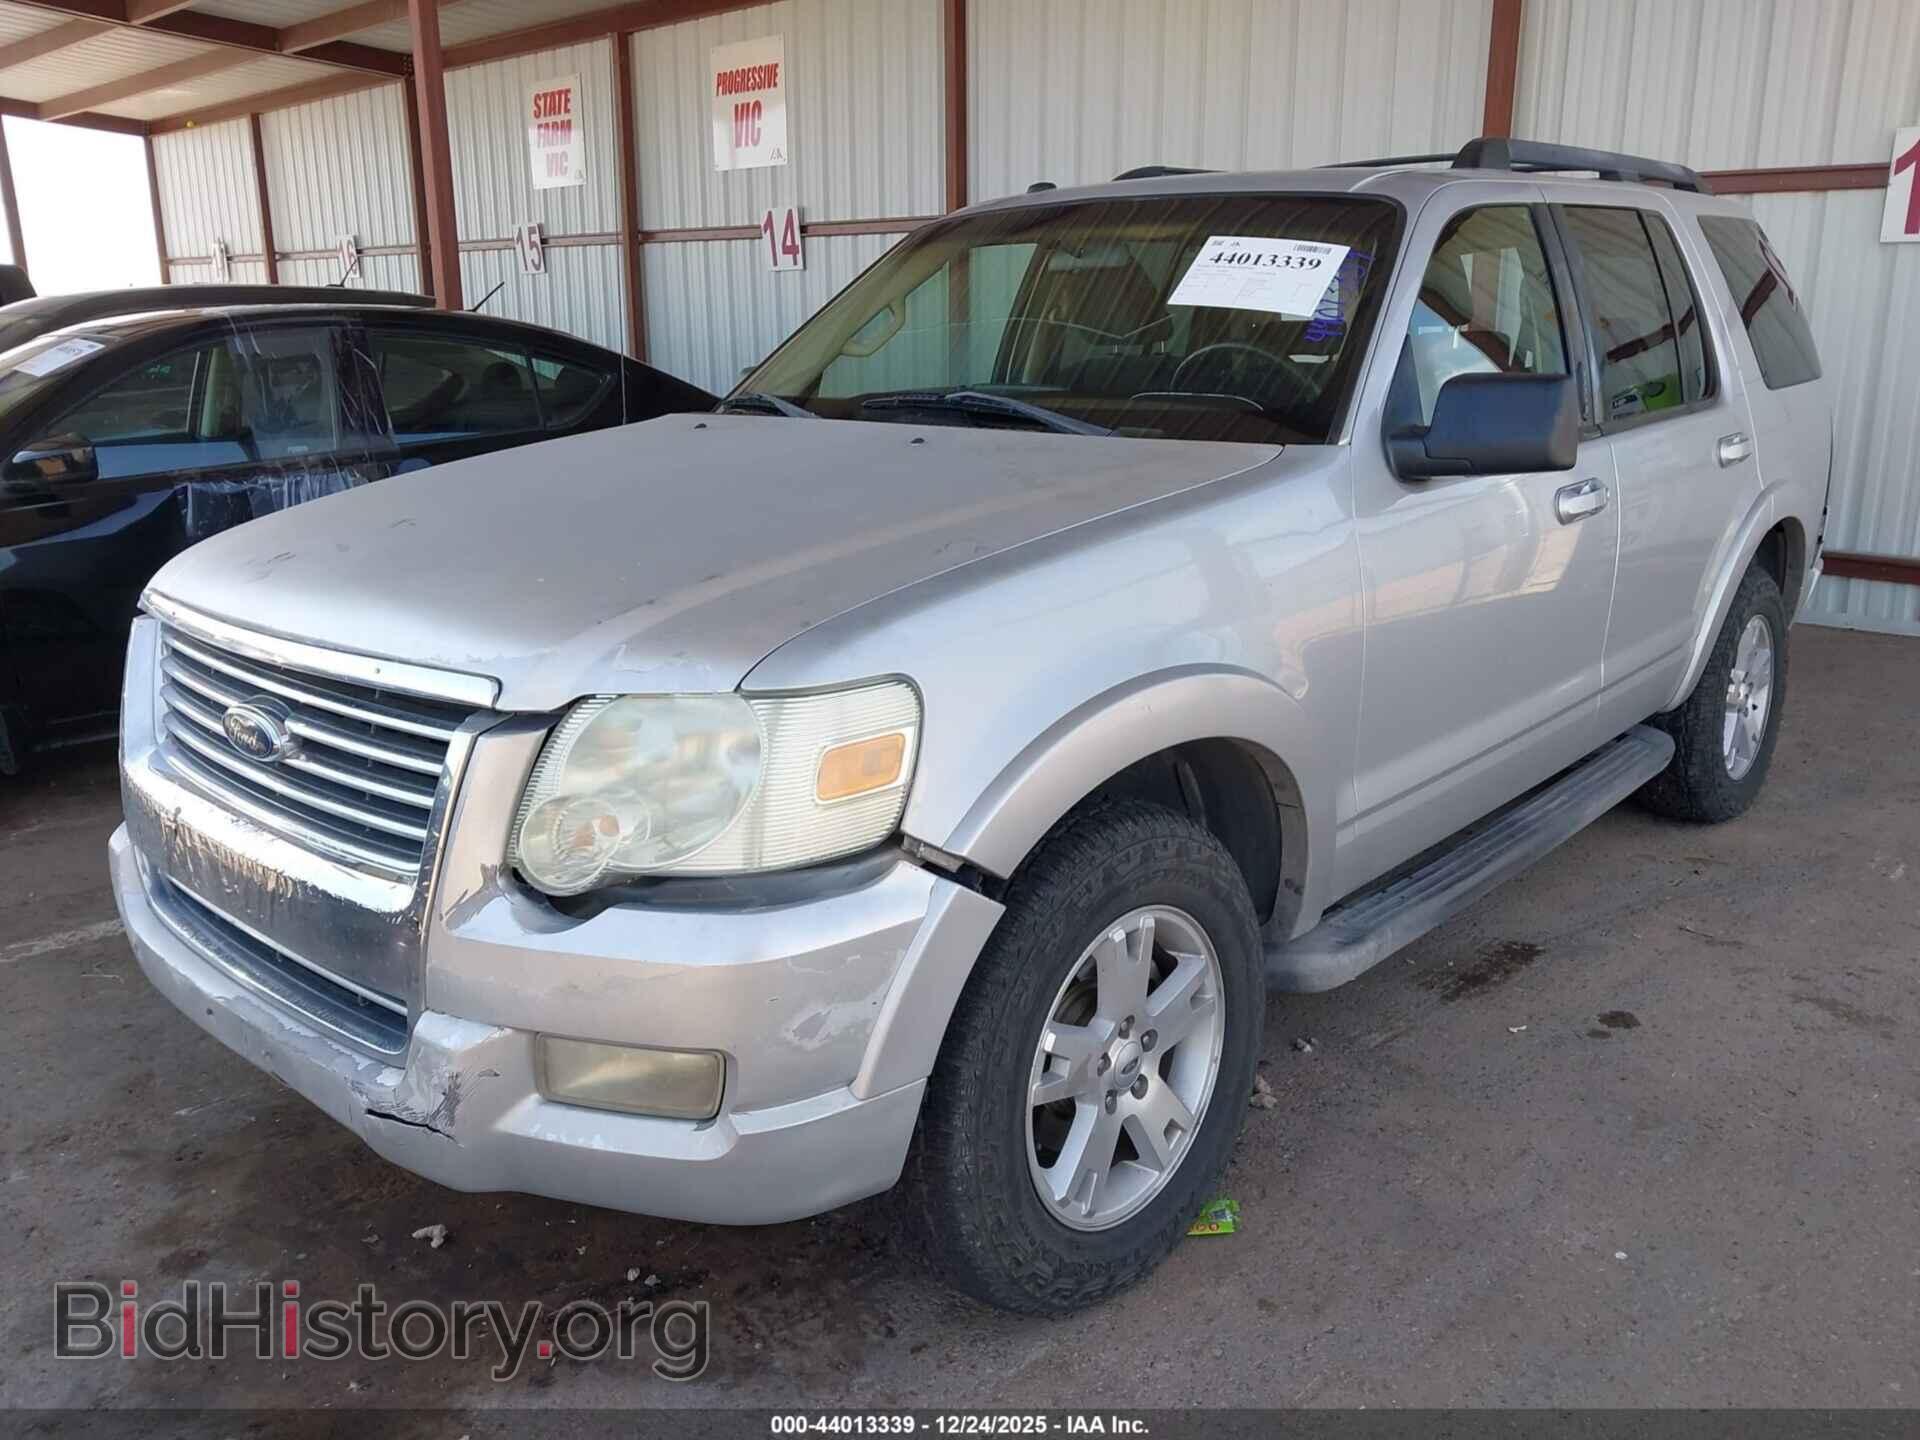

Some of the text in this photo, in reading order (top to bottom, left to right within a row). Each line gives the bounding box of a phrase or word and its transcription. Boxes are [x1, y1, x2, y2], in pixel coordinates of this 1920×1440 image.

[715, 62, 779, 97] PROGRESSIVE
[533, 88, 572, 119] STATE
[537, 119, 572, 149] FARM
[734, 100, 762, 148] VIC
[545, 150, 569, 178] VIC
[515, 226, 542, 271] 15
[763, 209, 800, 267] 14
[1208, 250, 1323, 271] 44013339
